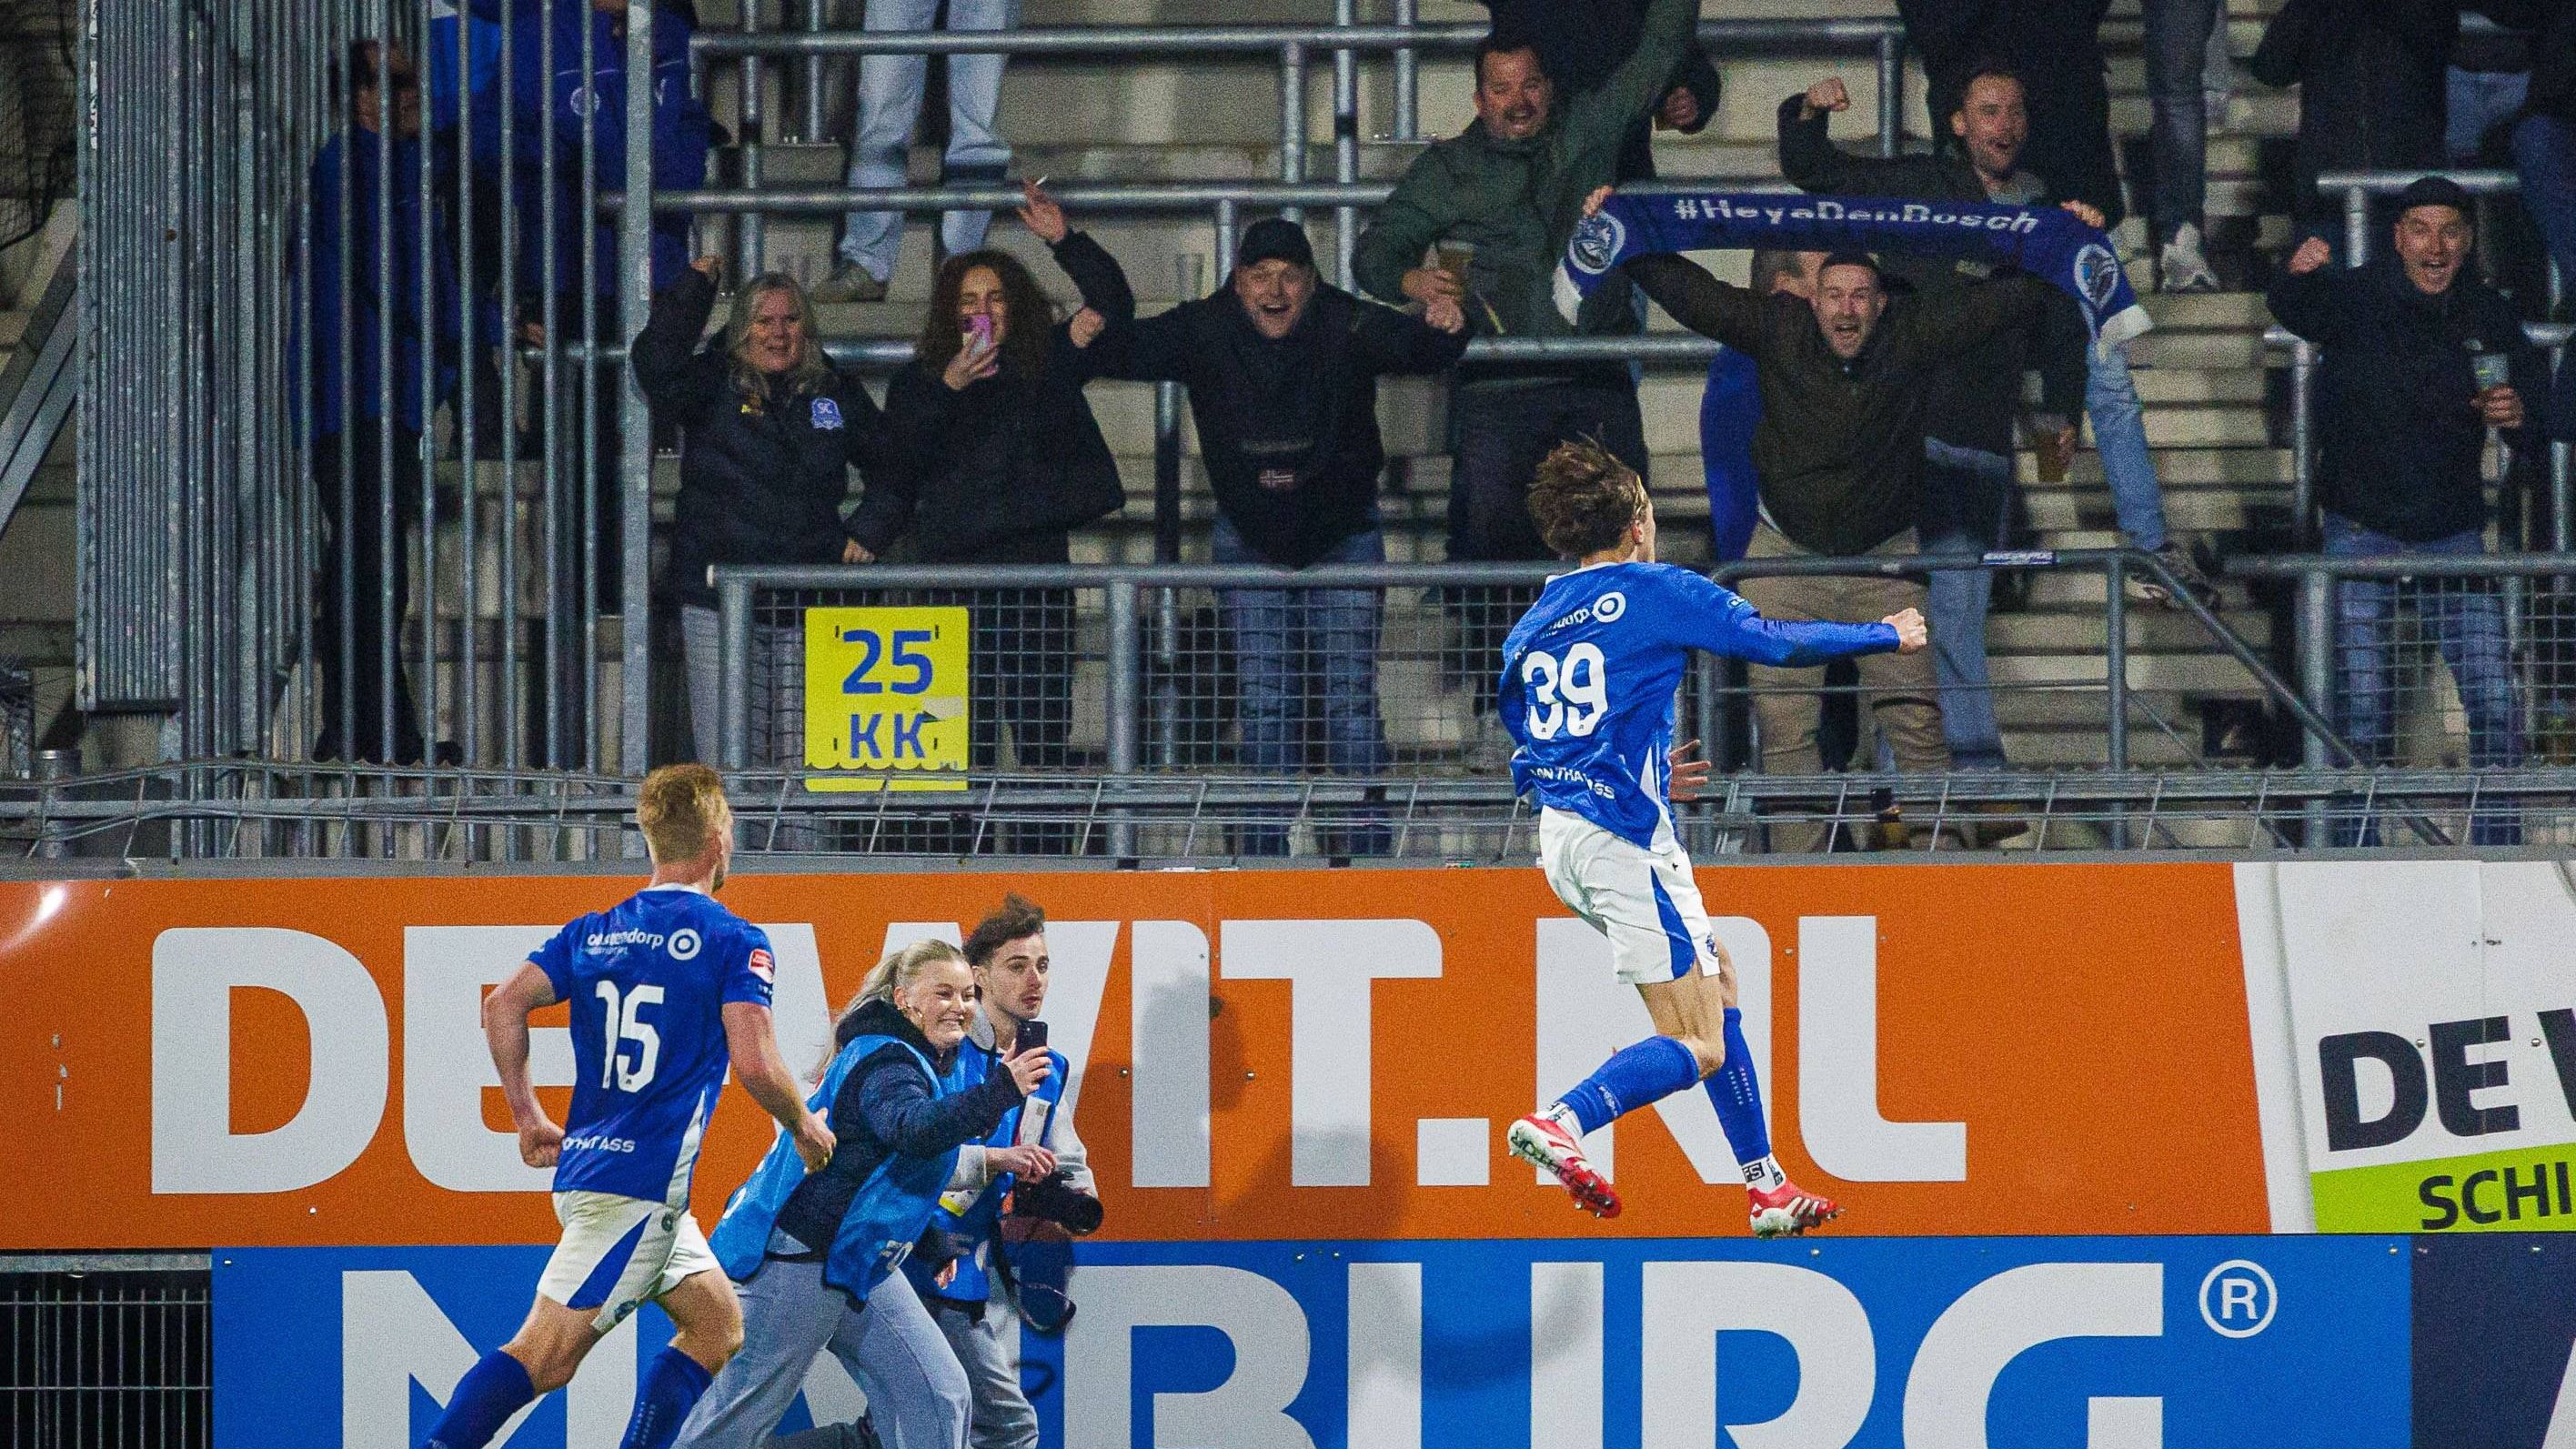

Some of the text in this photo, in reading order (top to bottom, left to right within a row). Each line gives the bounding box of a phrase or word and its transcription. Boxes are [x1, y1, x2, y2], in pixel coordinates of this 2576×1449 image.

[1674, 199, 2039, 234] #HeyaDenBosch
[841, 629, 933, 695] 25
[1522, 642, 1608, 740] 39
[850, 712, 926, 760] KK
[596, 980, 665, 1093] 15
[2319, 1015, 2521, 1152] DE
[2420, 1161, 2572, 1230] SCHI
